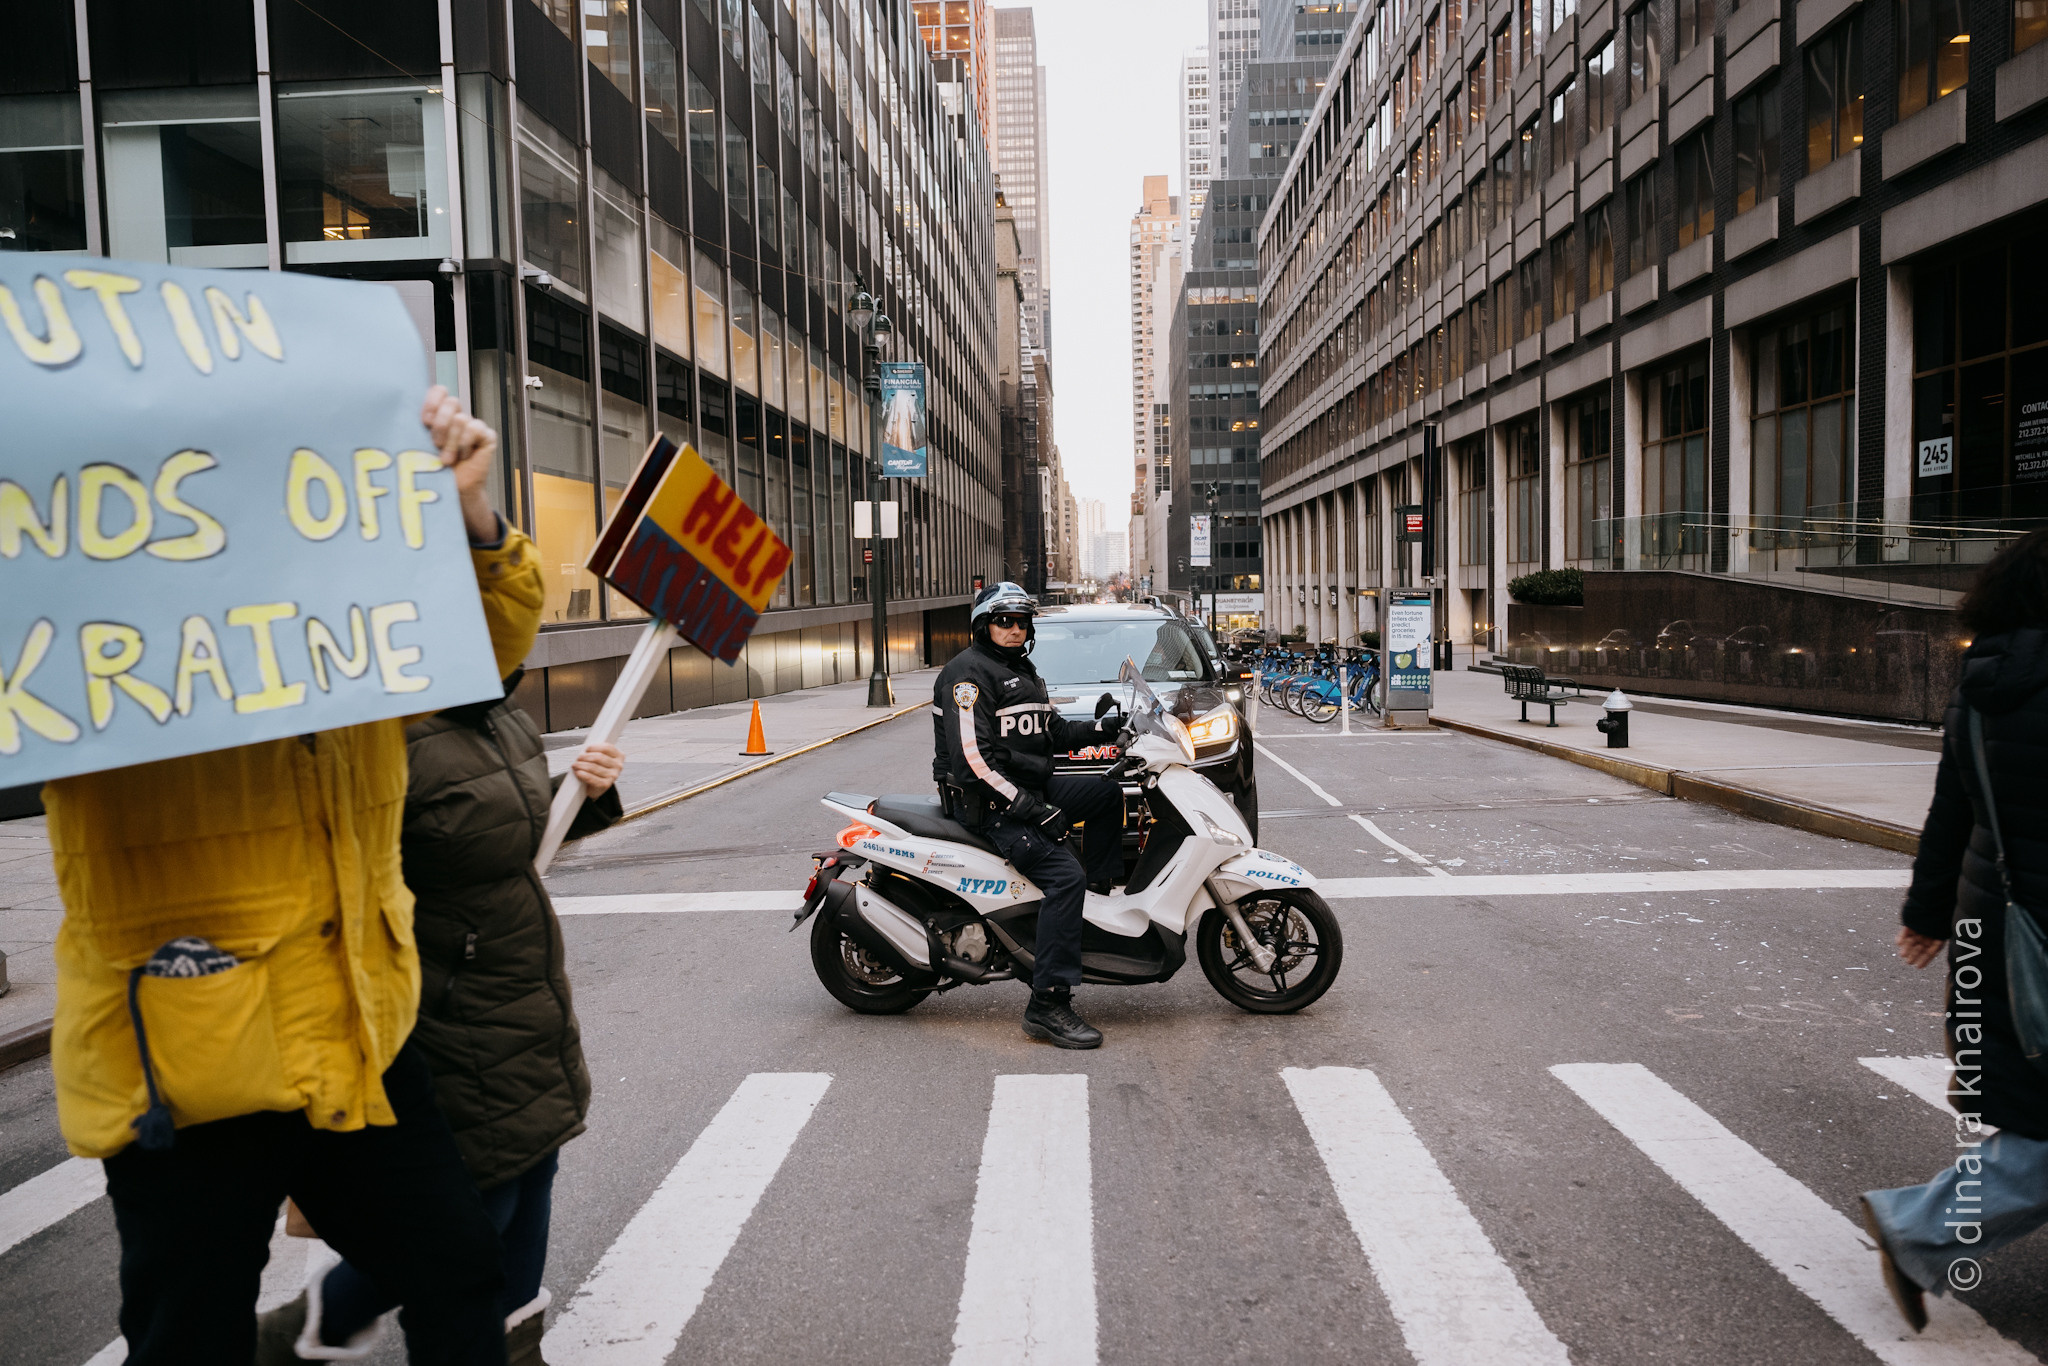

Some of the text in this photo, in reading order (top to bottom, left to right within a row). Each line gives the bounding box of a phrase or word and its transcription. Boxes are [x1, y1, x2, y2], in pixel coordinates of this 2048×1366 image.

[1923, 443, 1948, 465] 245
[286, 446, 446, 551] OFF
[682, 472, 794, 597] HELP
[1000, 712, 1049, 738] POL
[1068, 745, 1121, 760] GMC
[889, 847, 916, 859] PBMS
[930, 851, 955, 859] COURTESY
[922, 867, 943, 875] RESPECT
[926, 859, 966, 868] PROFESSIONALISM
[956, 876, 1007, 895] NYPD
[1245, 869, 1300, 886] POLICE
